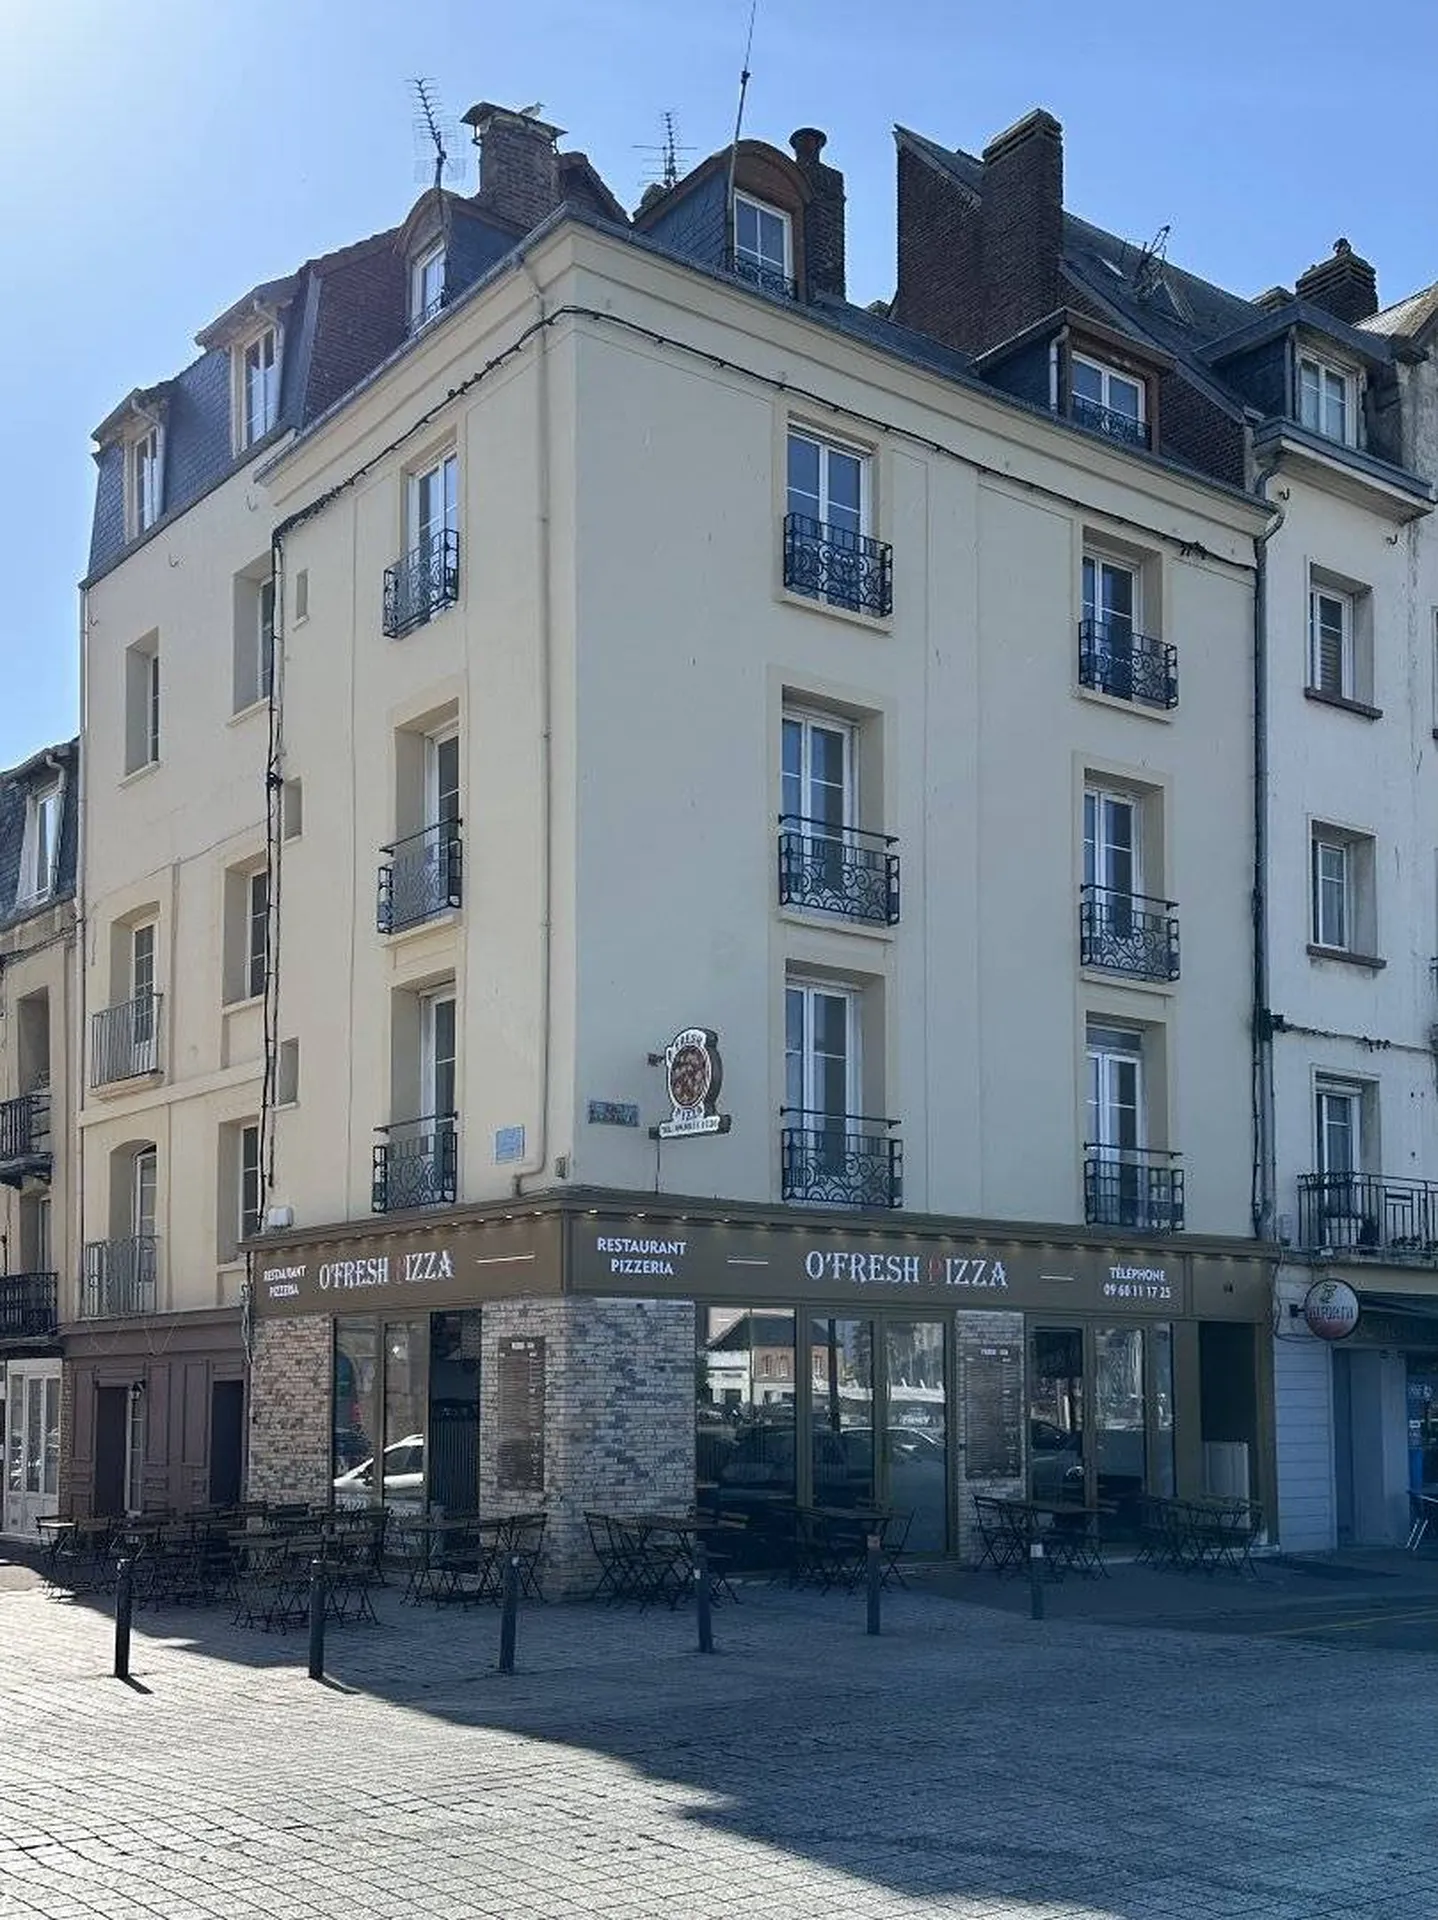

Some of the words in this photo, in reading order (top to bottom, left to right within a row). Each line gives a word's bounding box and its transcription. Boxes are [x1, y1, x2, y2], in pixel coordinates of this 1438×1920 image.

[596, 1237, 687, 1255] RESTAURANT
[318, 1257, 389, 1290] O'FRESH
[611, 1258, 674, 1275] PIZZERIA
[805, 1250, 920, 1283] O'FRESH
[927, 1256, 1009, 1288] PIZZA
[1109, 1263, 1166, 1282] TÉLÉPHONE
[1103, 1282, 1116, 1296] 09
[1132, 1284, 1144, 1298] 11
[1146, 1286, 1158, 1299] 17
[1159, 1286, 1171, 1299] 25
